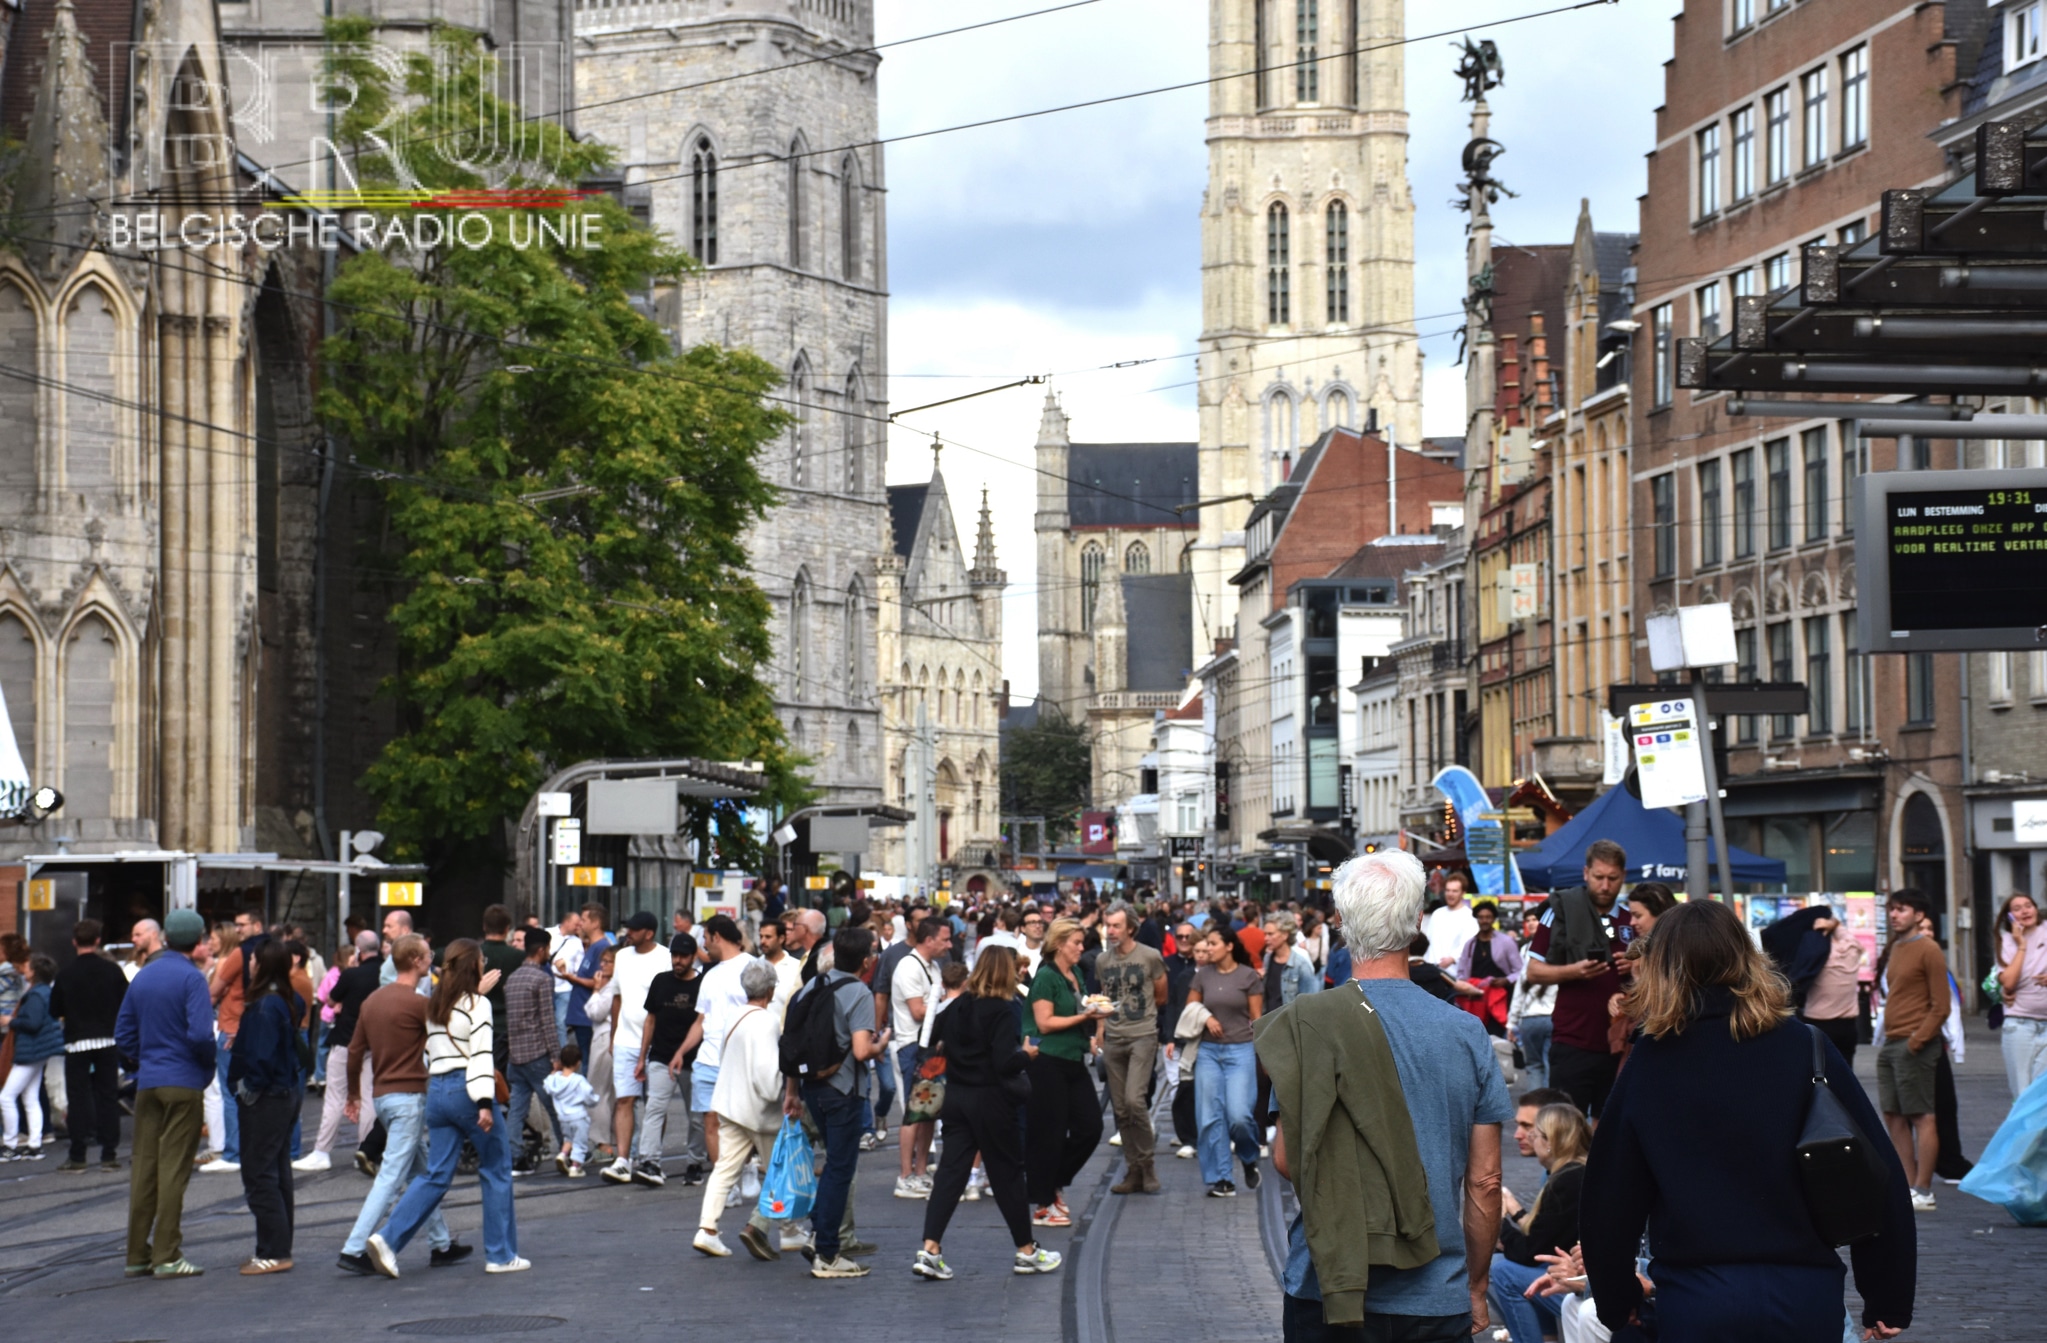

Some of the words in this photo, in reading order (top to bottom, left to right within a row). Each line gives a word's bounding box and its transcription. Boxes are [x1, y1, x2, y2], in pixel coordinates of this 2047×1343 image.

[1987, 491, 2032, 505] 19:31
[1923, 505, 1985, 517] BESTEMMING
[1894, 524, 1965, 536] RAADPLEEG
[2011, 522, 2035, 533] APP
[1894, 543, 1926, 554] VOOR
[1933, 541, 1997, 553] REALTIME
